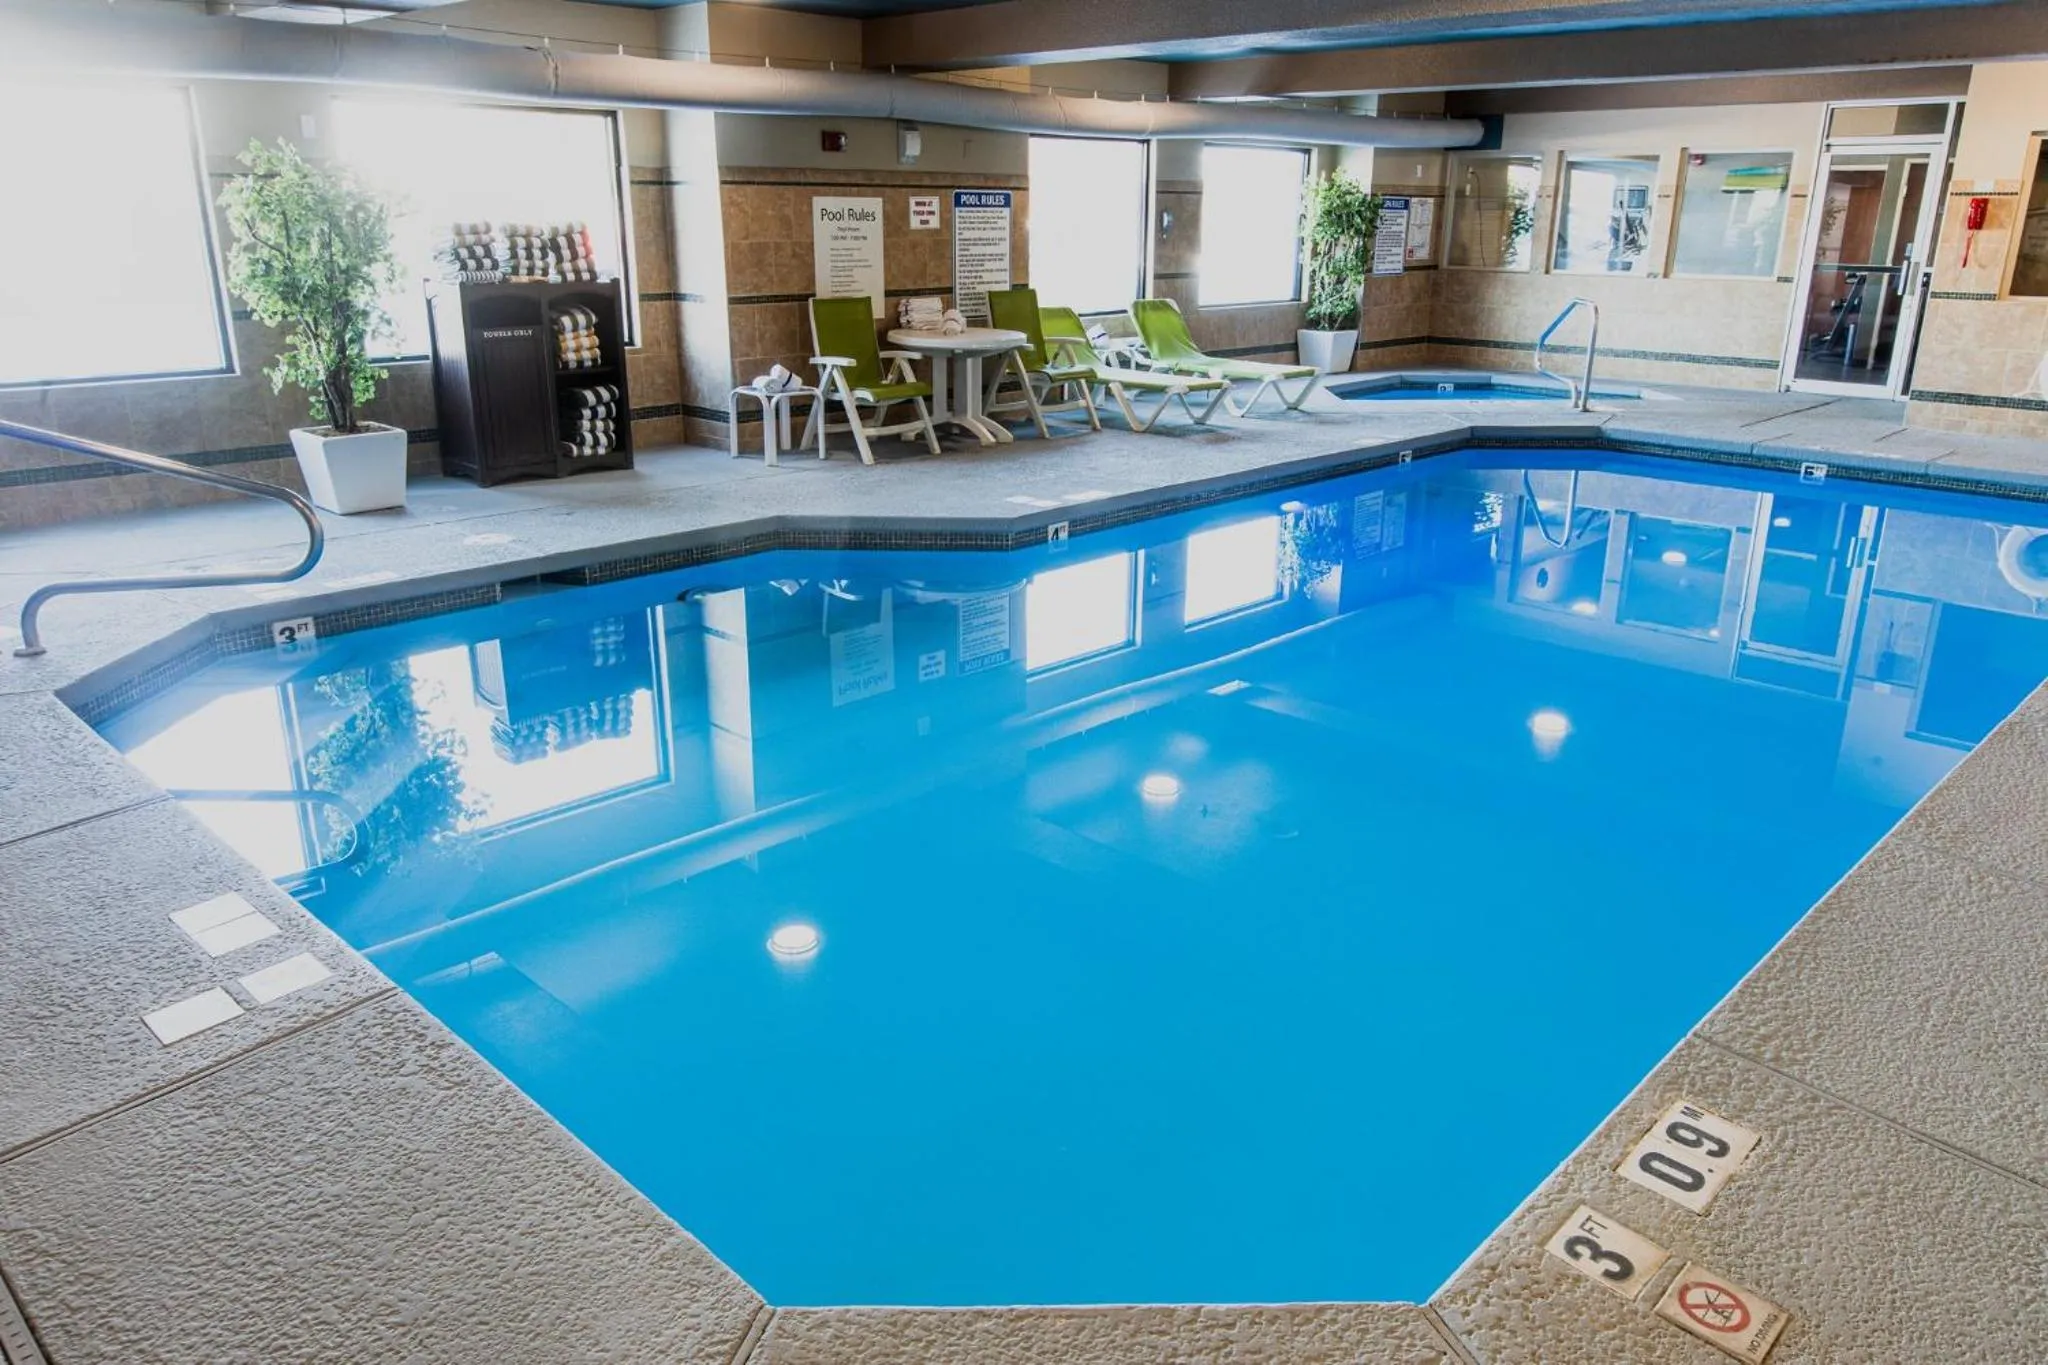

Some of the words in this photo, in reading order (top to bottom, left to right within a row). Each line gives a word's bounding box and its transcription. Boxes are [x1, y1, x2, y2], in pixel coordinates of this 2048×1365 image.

[960, 195, 980, 205] POOL
[981, 194, 1005, 205] RULES
[820, 207, 845, 222] Pool
[847, 207, 876, 222] Rules
[1804, 465, 1814, 476] 5
[279, 626, 298, 645] 3
[298, 622, 309, 633] FT
[1639, 1121, 1730, 1192] 0.9
[1578, 1214, 1610, 1240] FT
[1563, 1235, 1636, 1282] 3
[1746, 1338, 1762, 1355] NO
[1756, 1313, 1779, 1341] DIVING
